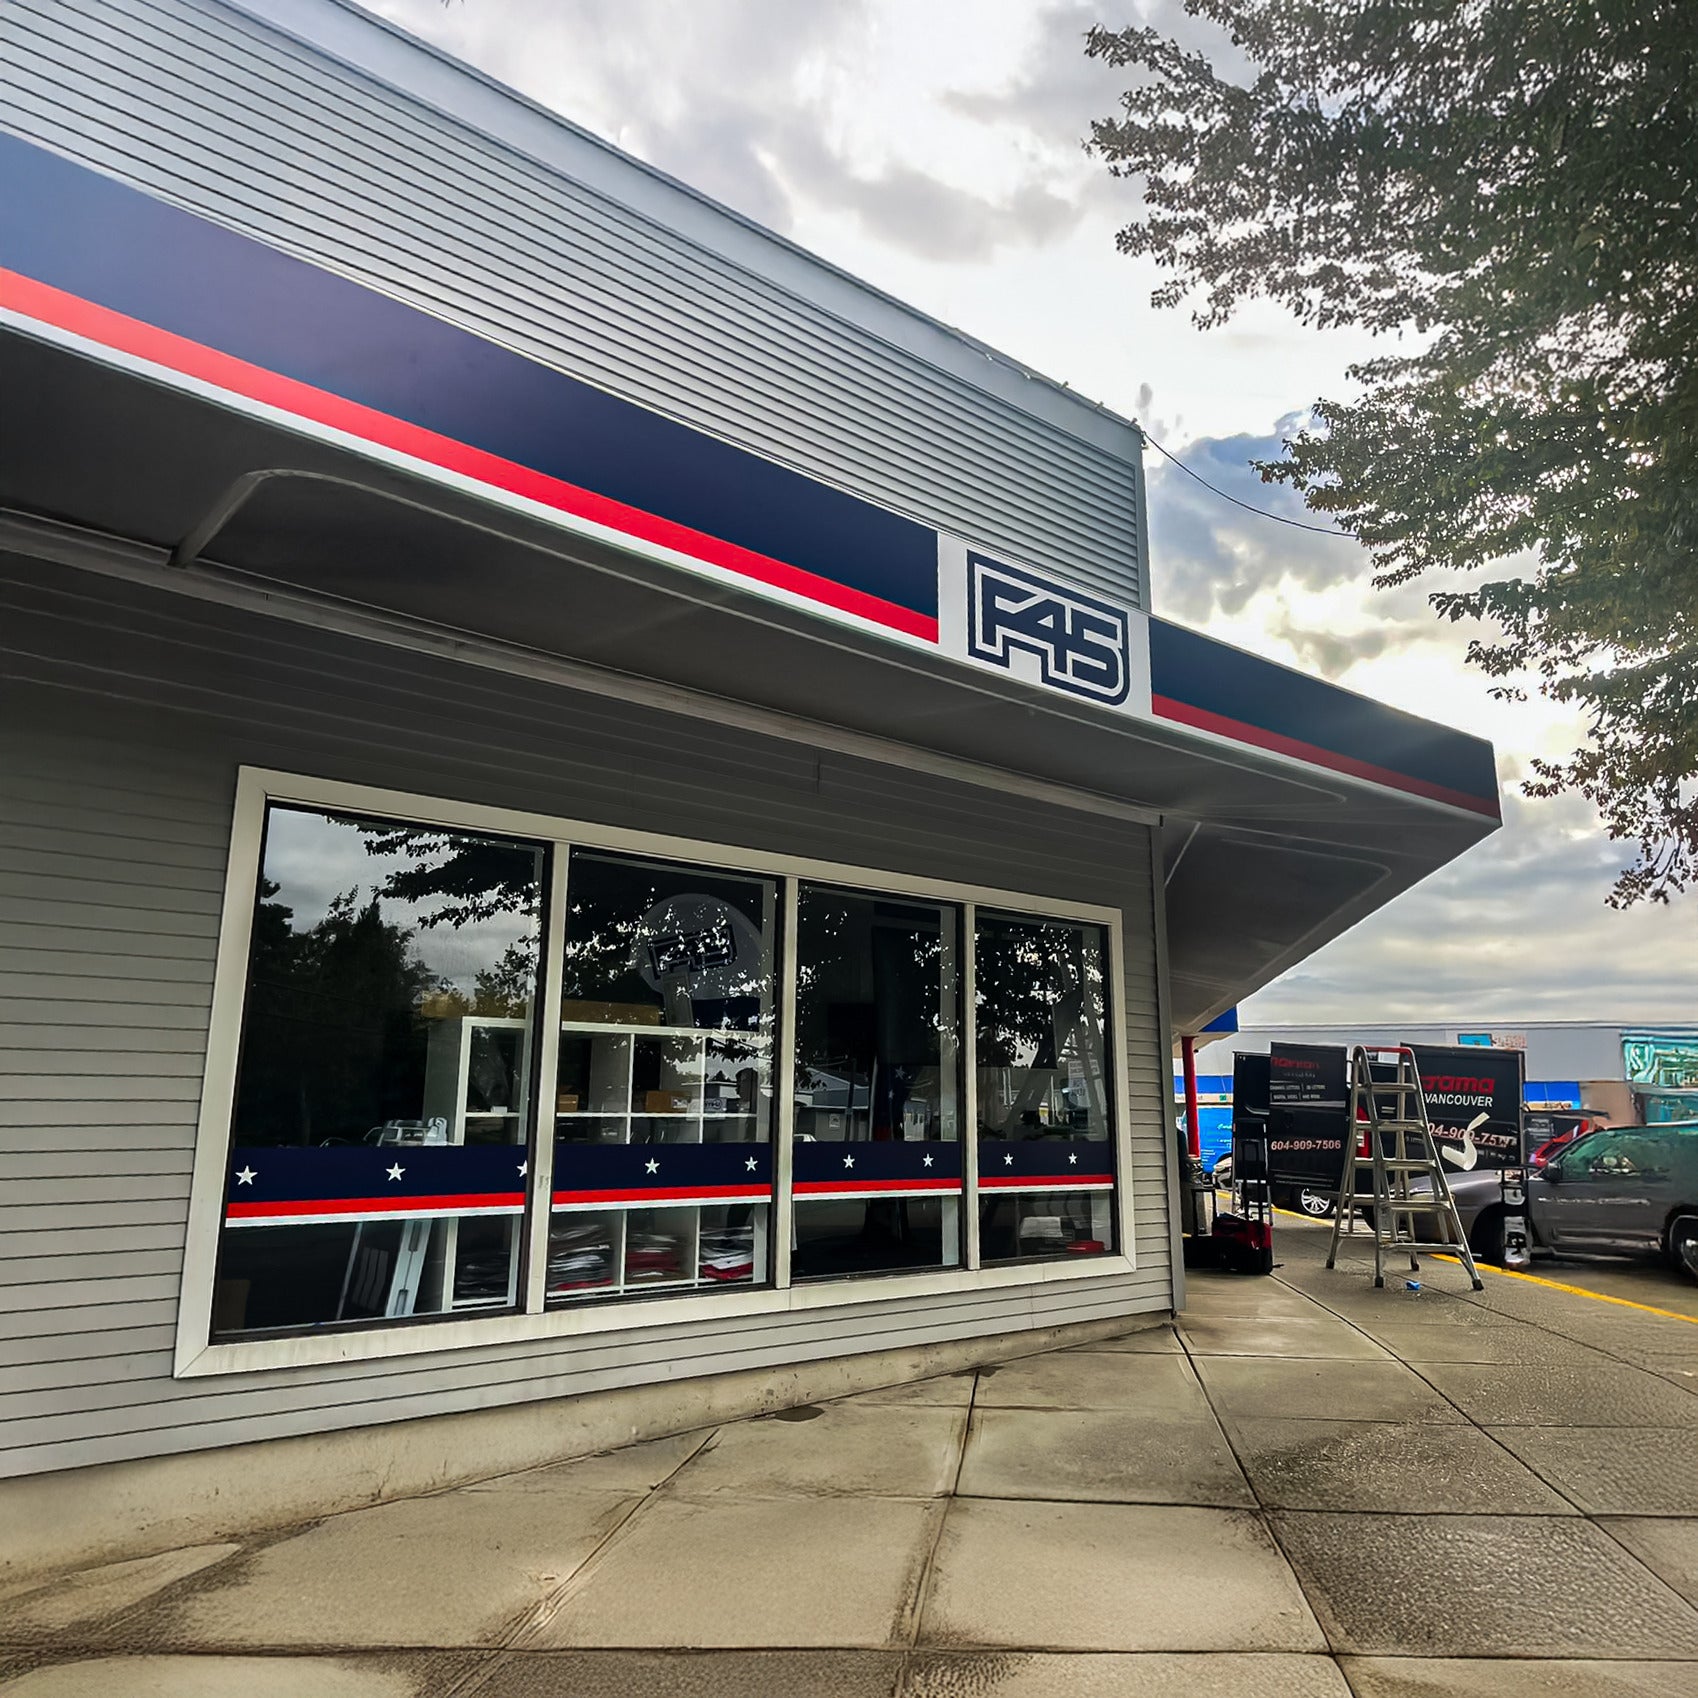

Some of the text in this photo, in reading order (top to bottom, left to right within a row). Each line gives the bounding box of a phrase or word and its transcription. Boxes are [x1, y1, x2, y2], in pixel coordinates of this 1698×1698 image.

[967, 549, 1130, 706] F45
[1425, 1093, 1493, 1108] VANCOUVER
[1271, 1140, 1342, 1151] 604-909-7506
